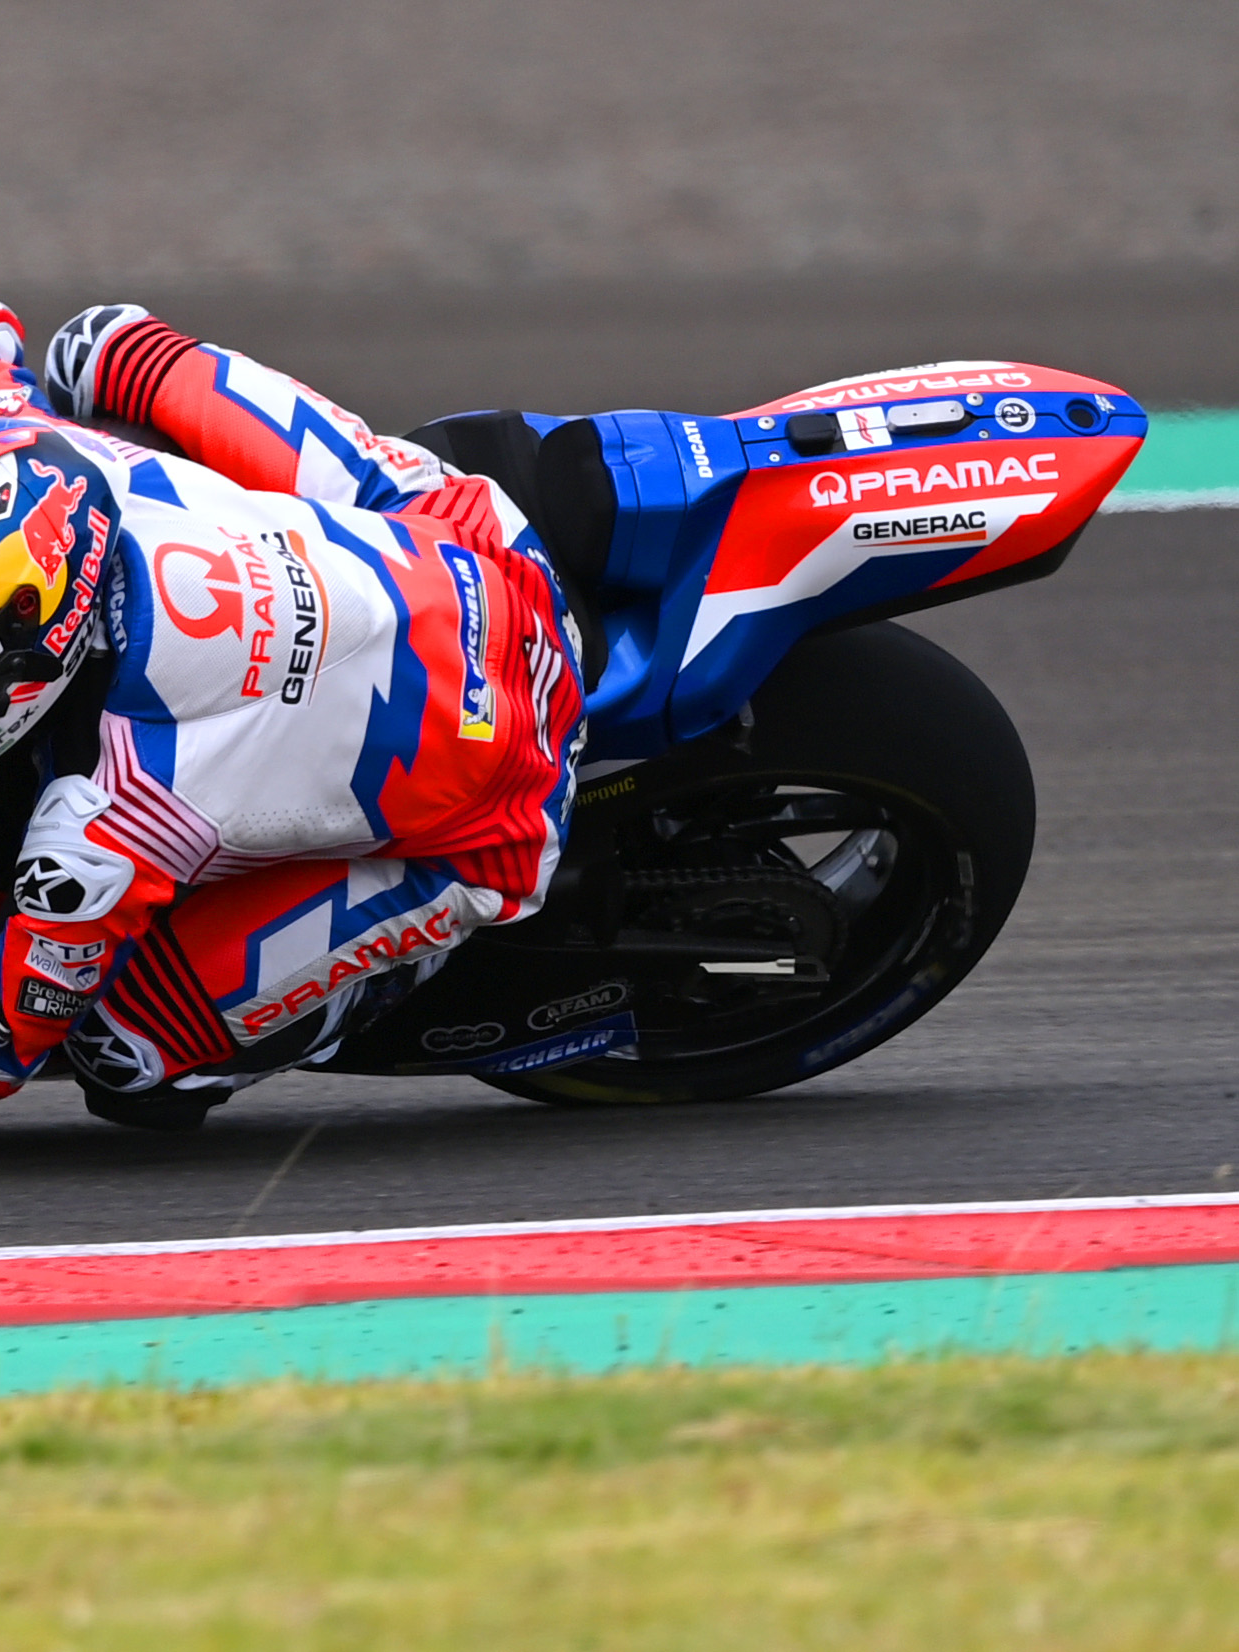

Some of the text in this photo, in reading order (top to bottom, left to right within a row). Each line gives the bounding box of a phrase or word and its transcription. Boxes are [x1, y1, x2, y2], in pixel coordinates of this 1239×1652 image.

[784, 374, 991, 410] PRAMAC
[682, 420, 713, 478] DUCATI
[850, 453, 1058, 502] PRAMAC
[853, 510, 986, 540] GENERAC
[42, 505, 111, 658] Red Bull
[218, 526, 276, 698] PRAMAC
[261, 531, 317, 706] GENERAC
[461, 558, 482, 677] MICHELIN
[39, 939, 102, 960] CTO
[241, 907, 452, 1036] PRAMAC
[546, 991, 611, 1023] AFAM
